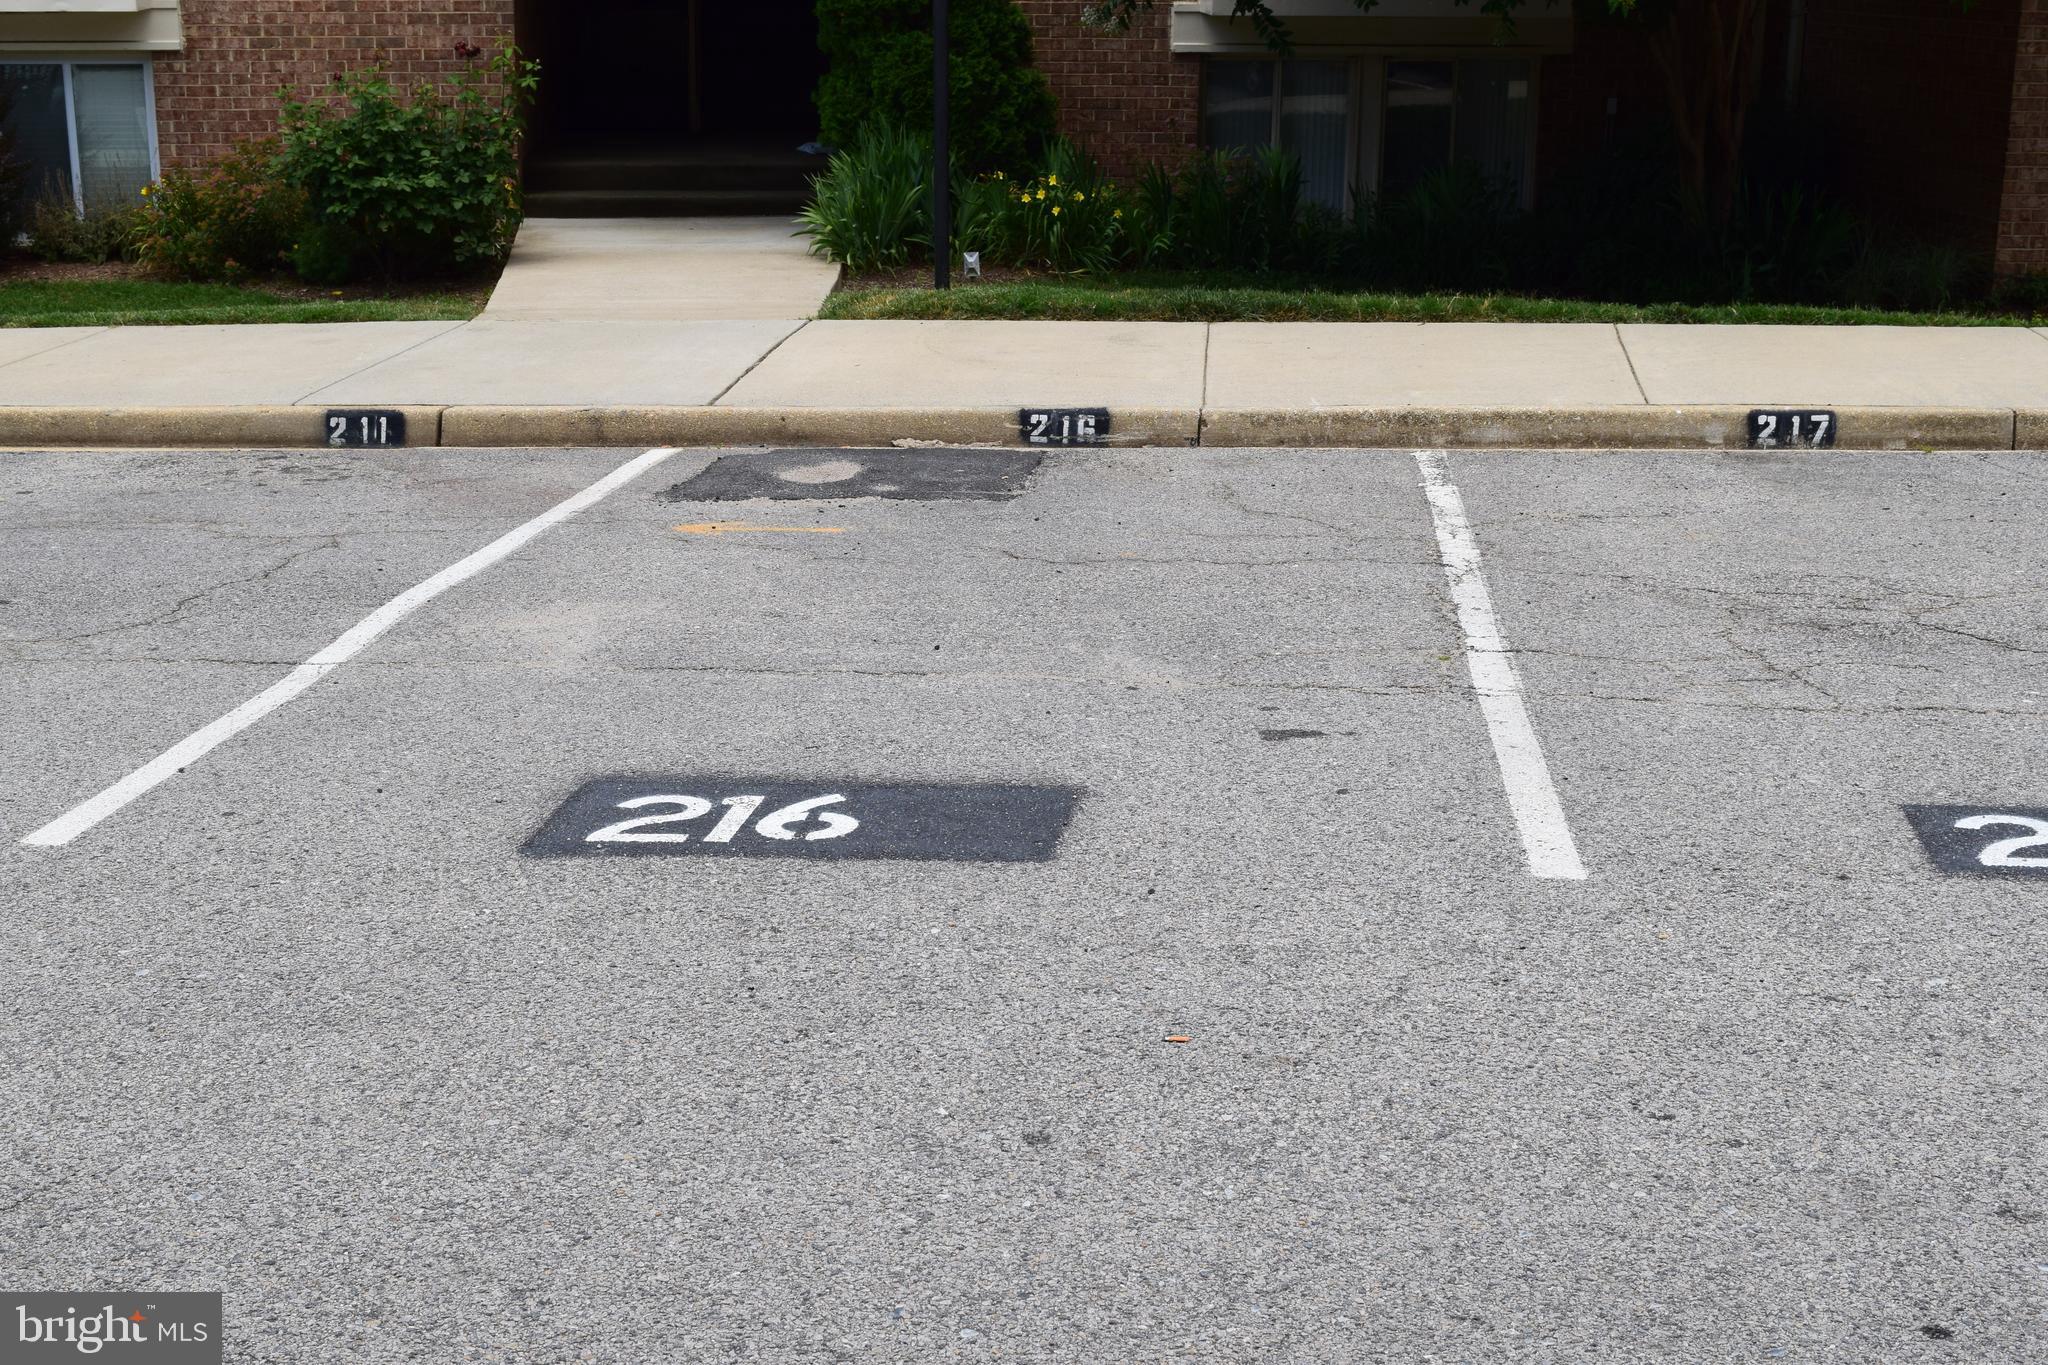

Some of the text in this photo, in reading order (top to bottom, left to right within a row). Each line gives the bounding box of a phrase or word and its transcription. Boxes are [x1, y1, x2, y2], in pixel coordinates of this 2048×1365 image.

[329, 416, 387, 445] 211
[1029, 414, 1096, 444] 216
[1757, 414, 1830, 446] 217
[585, 793, 860, 843] 216
